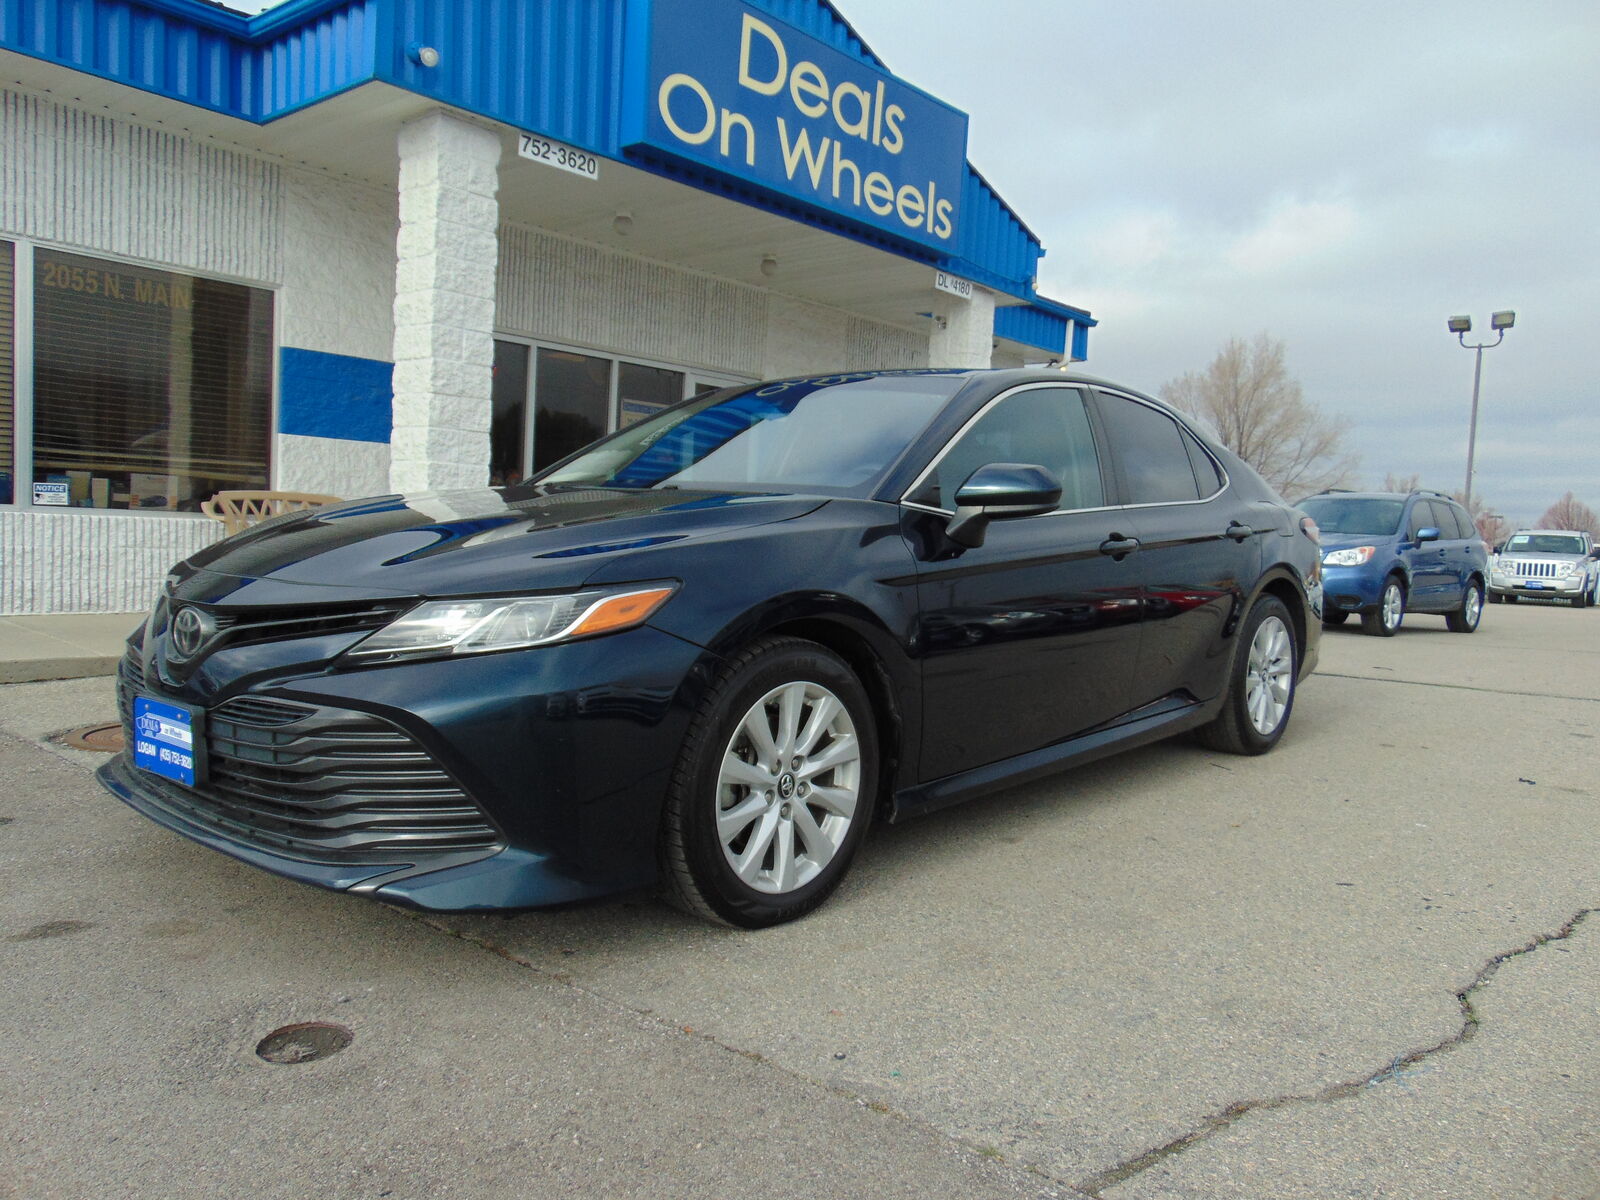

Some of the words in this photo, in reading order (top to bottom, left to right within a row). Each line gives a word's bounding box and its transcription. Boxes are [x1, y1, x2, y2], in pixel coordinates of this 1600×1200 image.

[738, 12, 905, 154] Deals
[521, 134, 596, 175] 752-3620
[658, 73, 756, 166] On
[777, 116, 953, 239] Wheels
[42, 261, 99, 294] 2055
[135, 278, 190, 308] MAIN
[938, 274, 948, 288] DL
[137, 740, 156, 757] LOGAN
